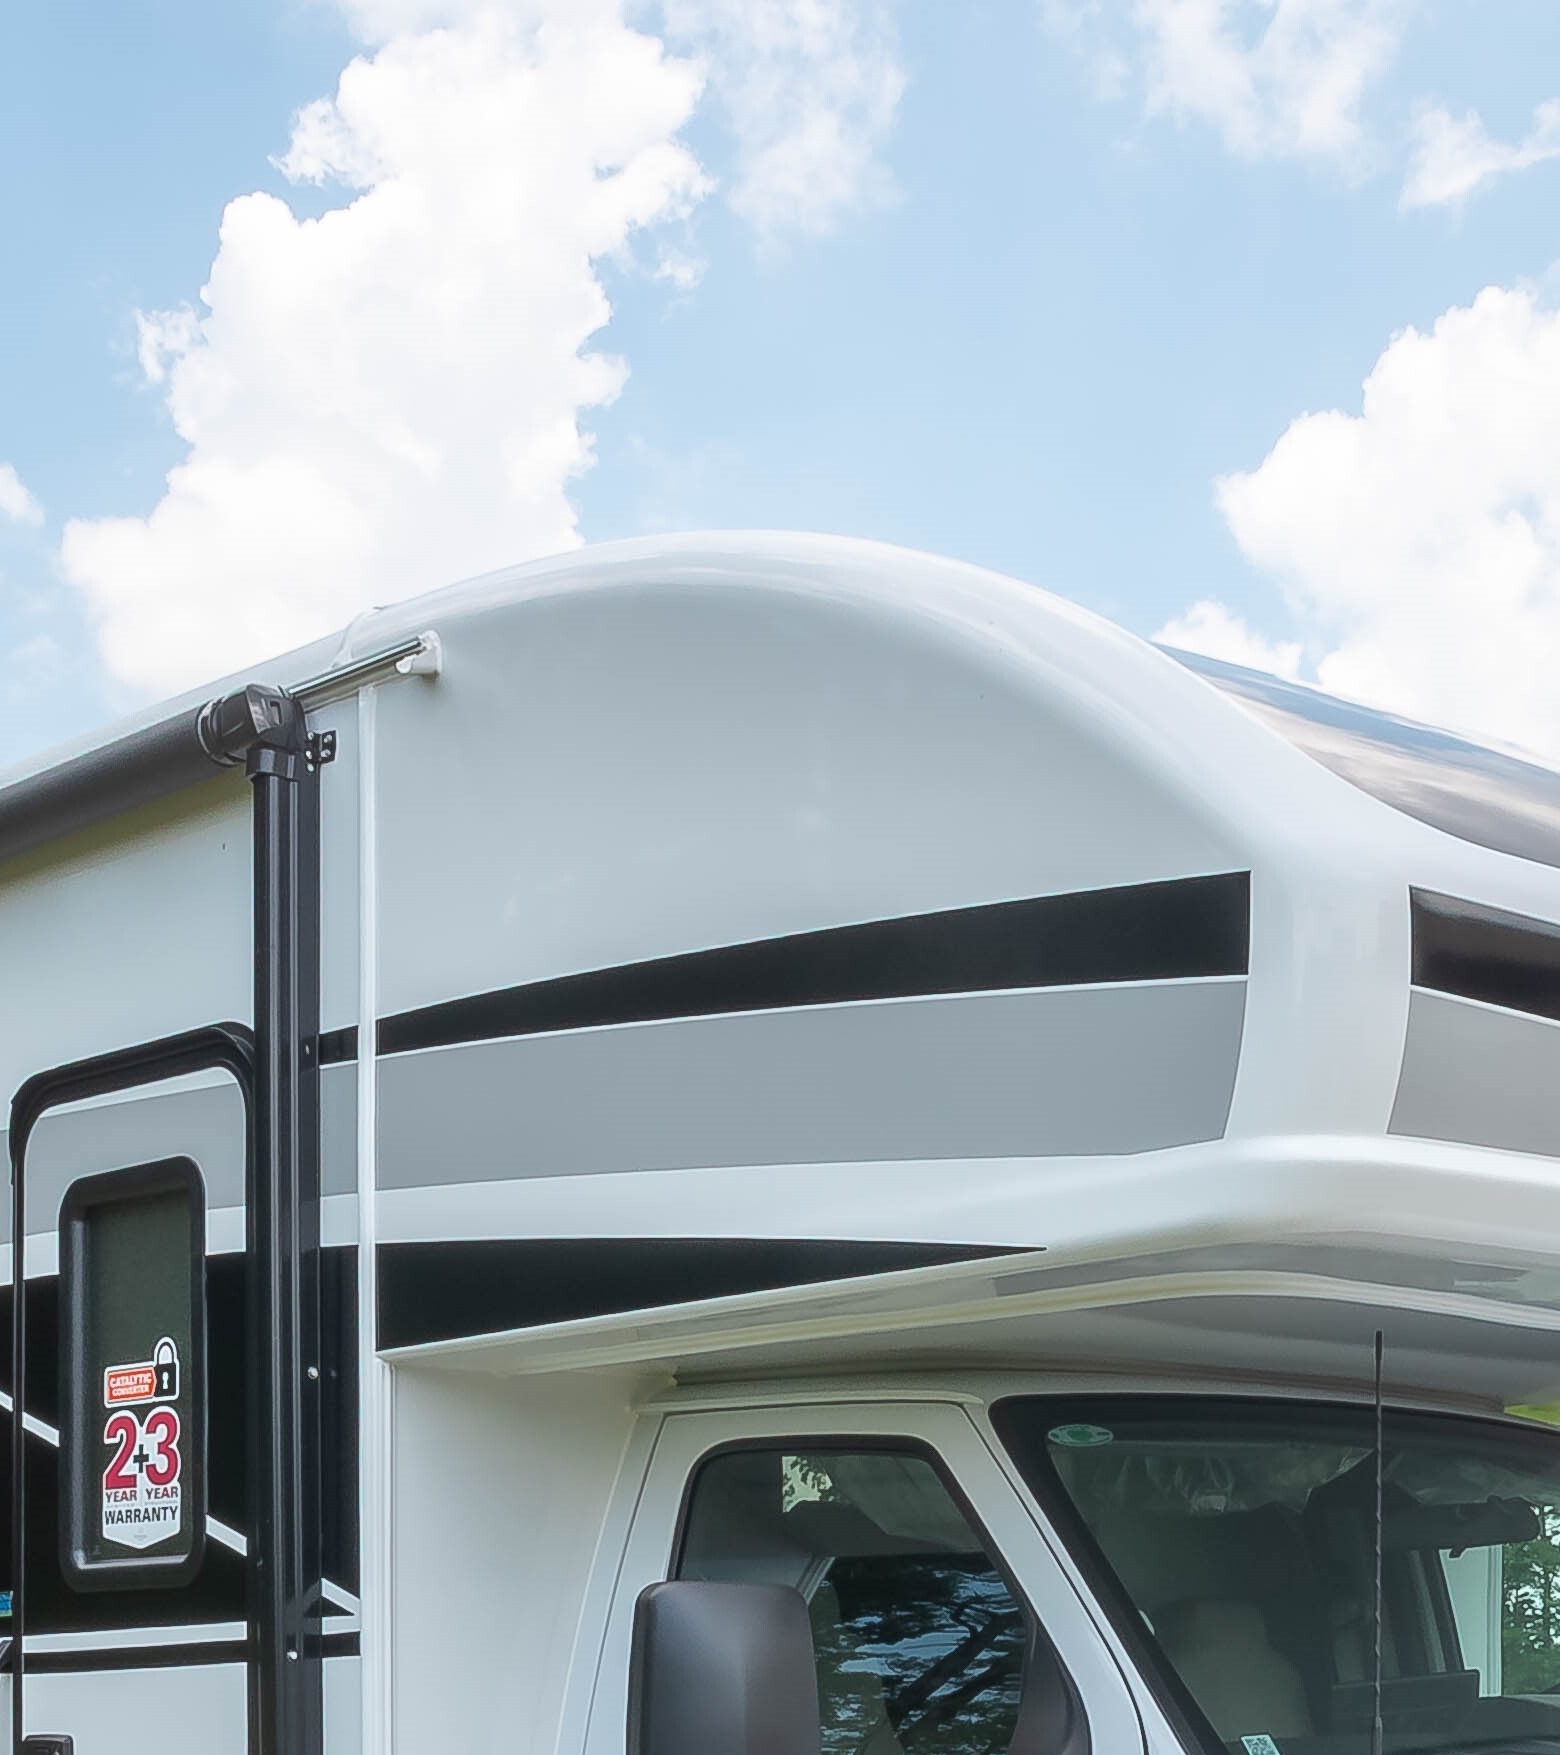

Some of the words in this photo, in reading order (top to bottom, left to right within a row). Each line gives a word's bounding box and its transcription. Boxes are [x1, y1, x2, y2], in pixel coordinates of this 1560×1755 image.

[105, 1489, 137, 1503] YEAR
[145, 1486, 178, 1500] YEAR
[104, 1505, 178, 1525] WARRANTY
